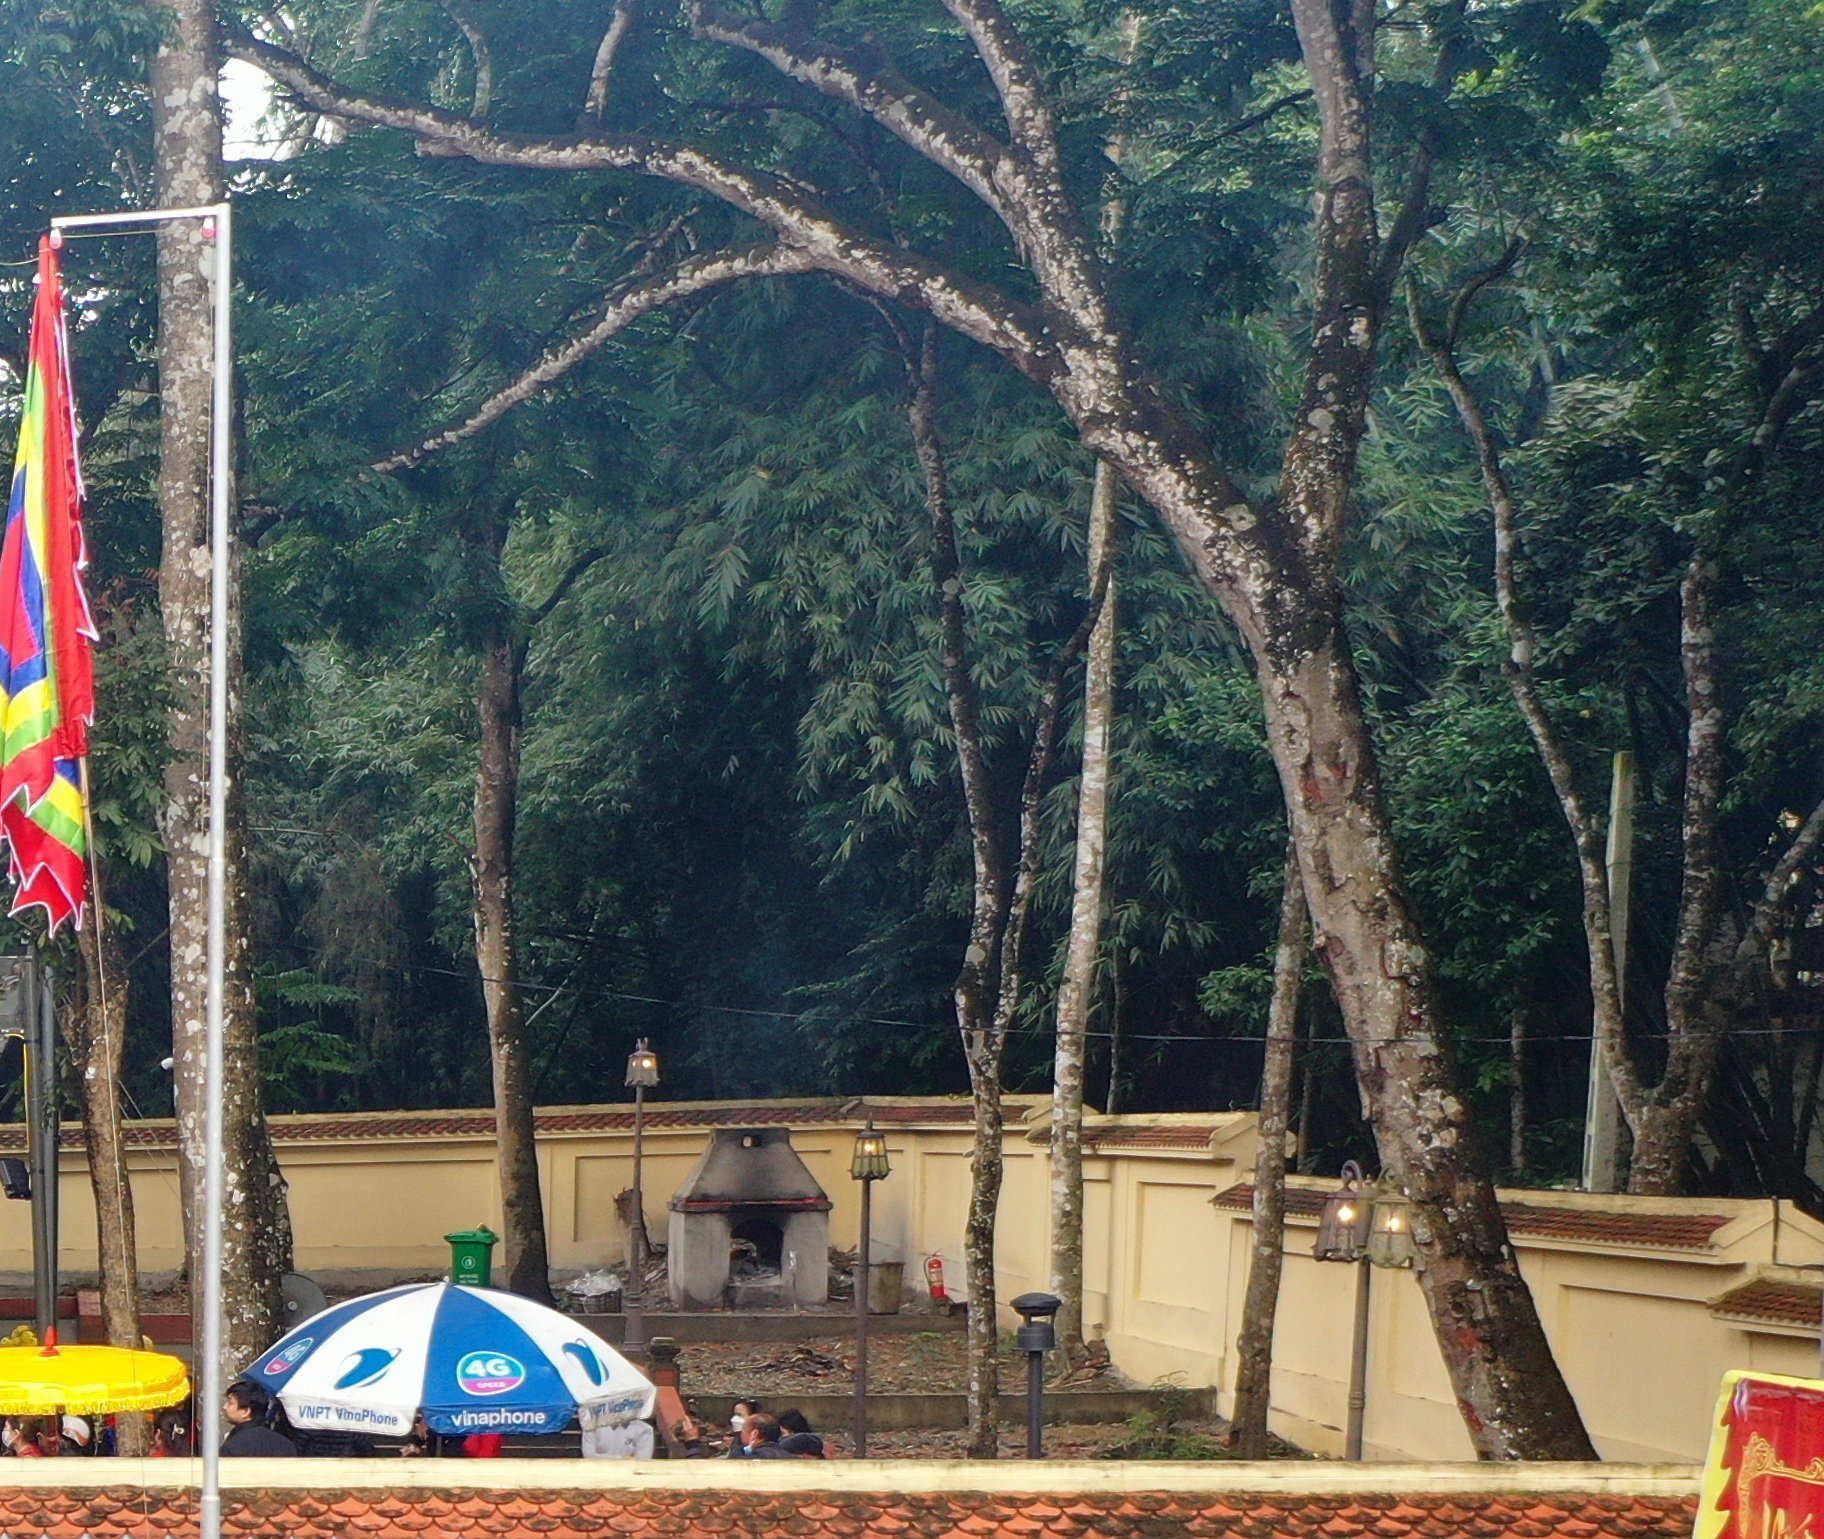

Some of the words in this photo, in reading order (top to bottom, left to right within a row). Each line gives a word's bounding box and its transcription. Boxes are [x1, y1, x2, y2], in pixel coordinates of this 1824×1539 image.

[465, 1358, 510, 1377] 4G
[299, 1405, 331, 1419] VNPT
[451, 1408, 546, 1427] vinaphone
